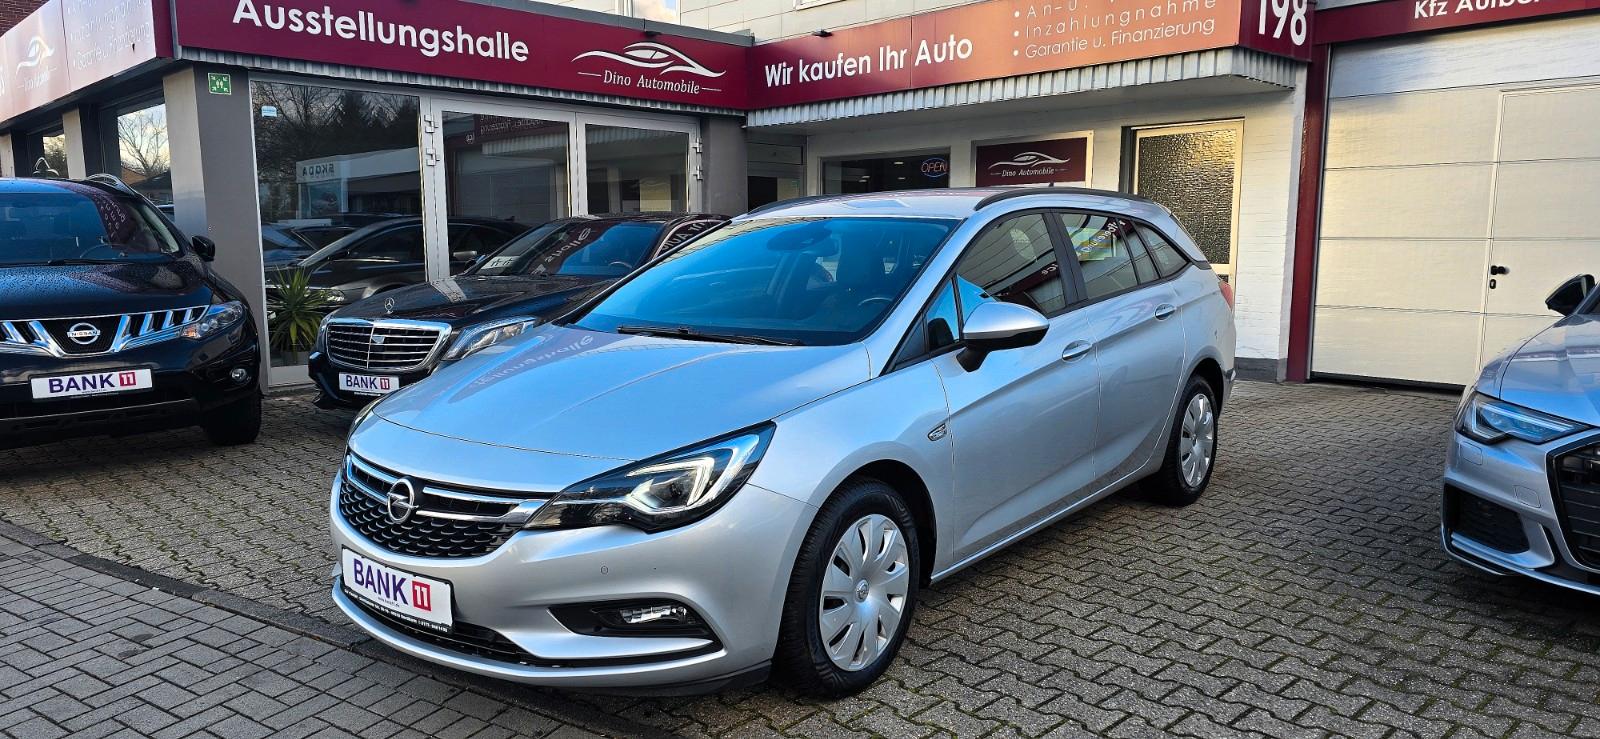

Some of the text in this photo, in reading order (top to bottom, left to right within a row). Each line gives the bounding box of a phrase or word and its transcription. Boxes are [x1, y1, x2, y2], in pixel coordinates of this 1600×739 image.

[1025, 0, 1216, 39] Inzahlungnahme
[1258, 0, 1308, 46] 198
[1414, 0, 1448, 19] Kfz
[232, 0, 529, 62] Ausstellungshalle
[1025, 17, 1215, 59] Garantie u. Finanzierung
[765, 34, 973, 88] Wir kaufen Ihr Auto
[603, 70, 700, 95] Dino Automobile
[921, 161, 948, 173] OPEN
[1001, 167, 1055, 177] Dino Automobile
[48, 373, 135, 394] BANK 11
[346, 375, 390, 390] BANK 11
[353, 558, 430, 609] BANK 11
